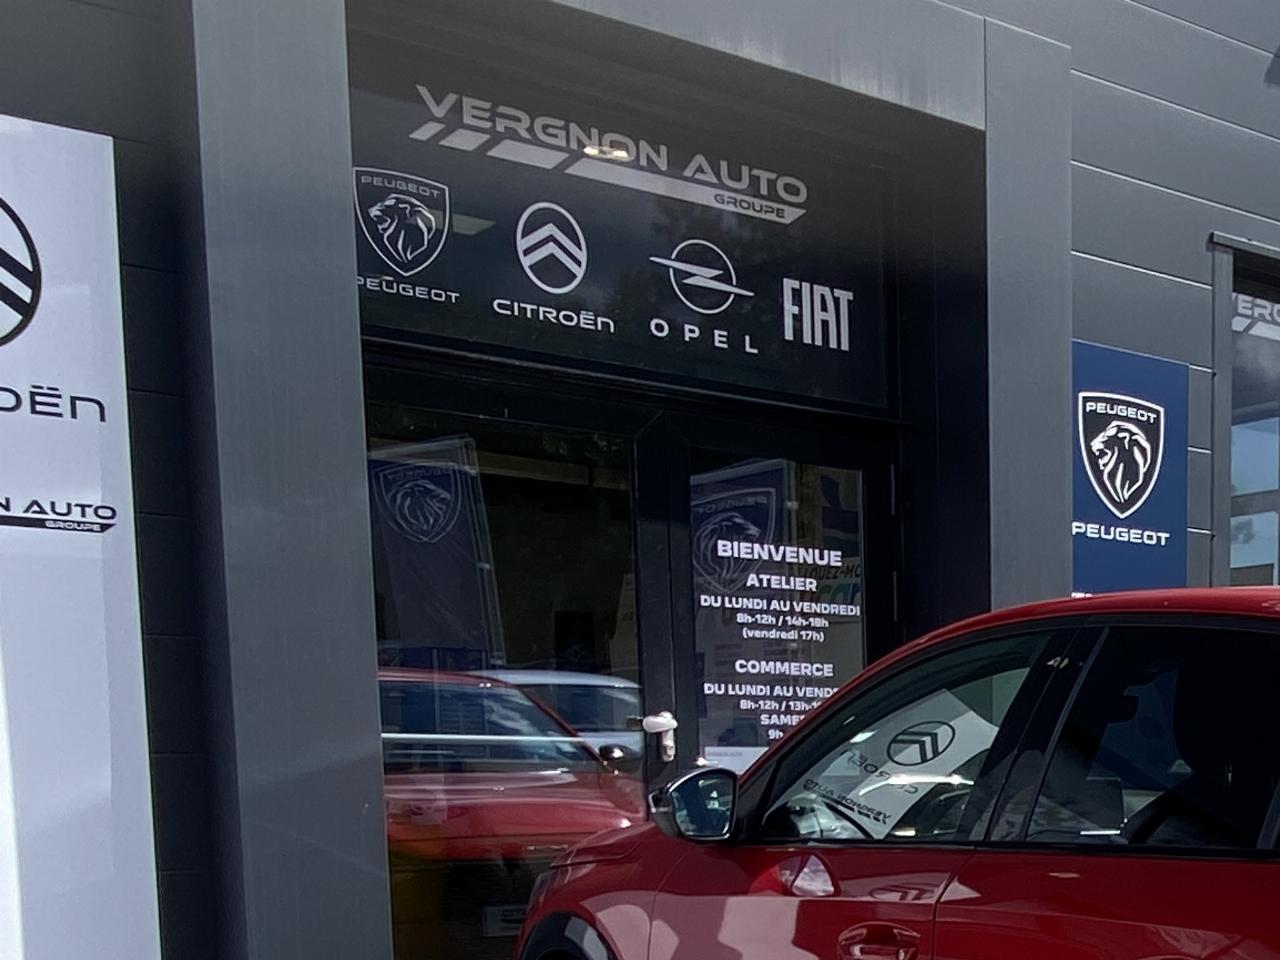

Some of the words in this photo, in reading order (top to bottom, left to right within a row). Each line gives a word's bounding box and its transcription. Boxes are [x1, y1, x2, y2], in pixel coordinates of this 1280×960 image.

[415, 84, 668, 171] VERGNON
[683, 154, 808, 203] AUTO
[361, 175, 440, 198] PEUGEOT
[713, 193, 786, 218] GROUPE
[782, 277, 854, 351] FIAT
[650, 317, 759, 354] OPEL
[1085, 401, 1158, 424] PEUGEOT
[23, 500, 117, 520] AUTO
[45, 520, 102, 532] GROUPE
[1072, 521, 1170, 546] PEUGEOT
[717, 539, 842, 567] BIENVENUE
[746, 573, 818, 592] ATELIER
[700, 595, 722, 608] DU
[724, 597, 767, 611] LUNDI
[769, 599, 790, 612] AU
[793, 601, 861, 617] VENDREDI
[743, 627, 798, 641] (vendredi
[800, 631, 825, 643] 17h)
[735, 659, 834, 677] COMMERCE
[704, 683, 725, 695] DU
[728, 684, 770, 696] LUNDI
[773, 686, 793, 697] AU
